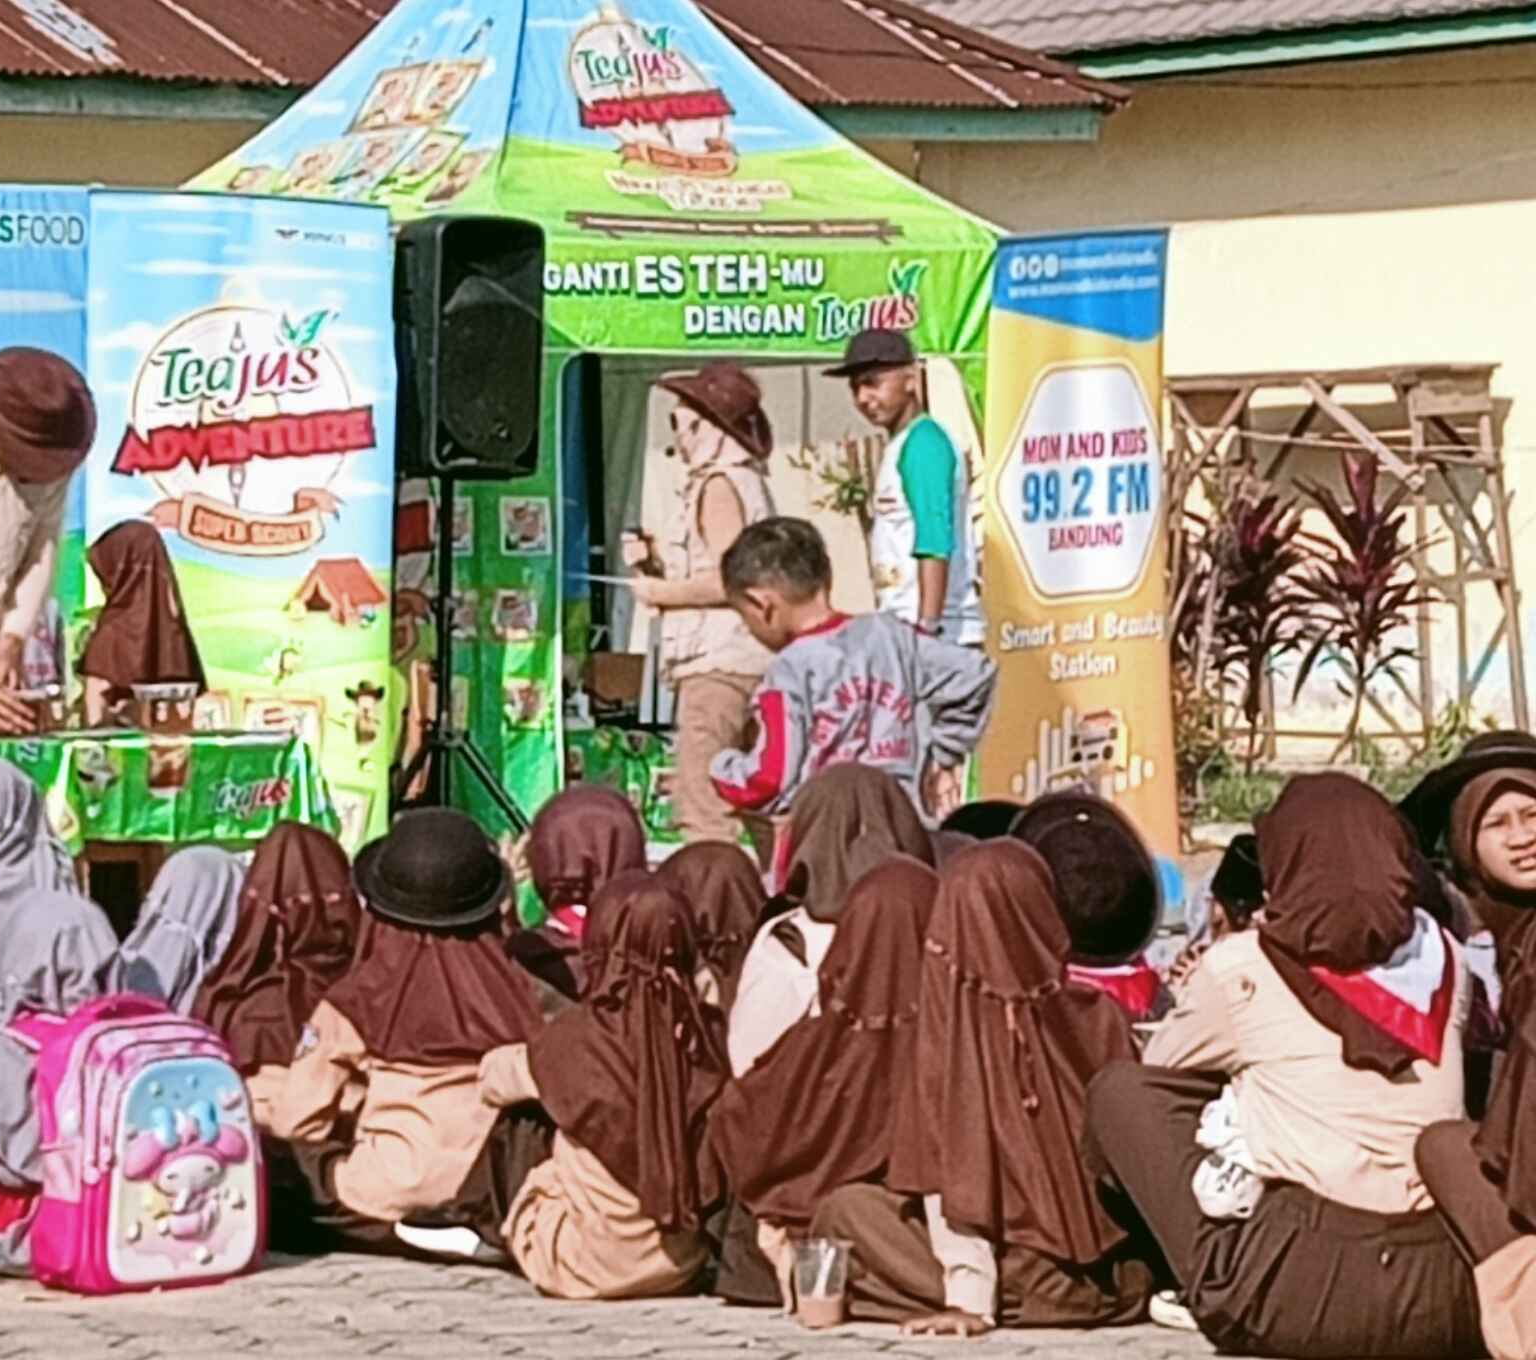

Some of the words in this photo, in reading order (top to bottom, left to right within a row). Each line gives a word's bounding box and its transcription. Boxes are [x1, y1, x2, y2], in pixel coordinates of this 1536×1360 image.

[543, 262, 630, 292] GANTI
[635, 254, 685, 294] ES
[684, 304, 806, 336] DENGAN
[154, 345, 322, 410] Teajus
[110, 404, 377, 476] ADVENTURE
[1022, 434, 1062, 464] MOM
[1066, 431, 1105, 460] AND
[1111, 427, 1149, 456] KIDS
[1022, 465, 1094, 523] 99.2
[1106, 462, 1151, 515] FM
[1048, 522, 1124, 552] BANDUNG
[999, 620, 1056, 651] Smart
[1062, 614, 1095, 642] and
[1104, 610, 1165, 640] Beauty
[1049, 651, 1118, 682] Station
